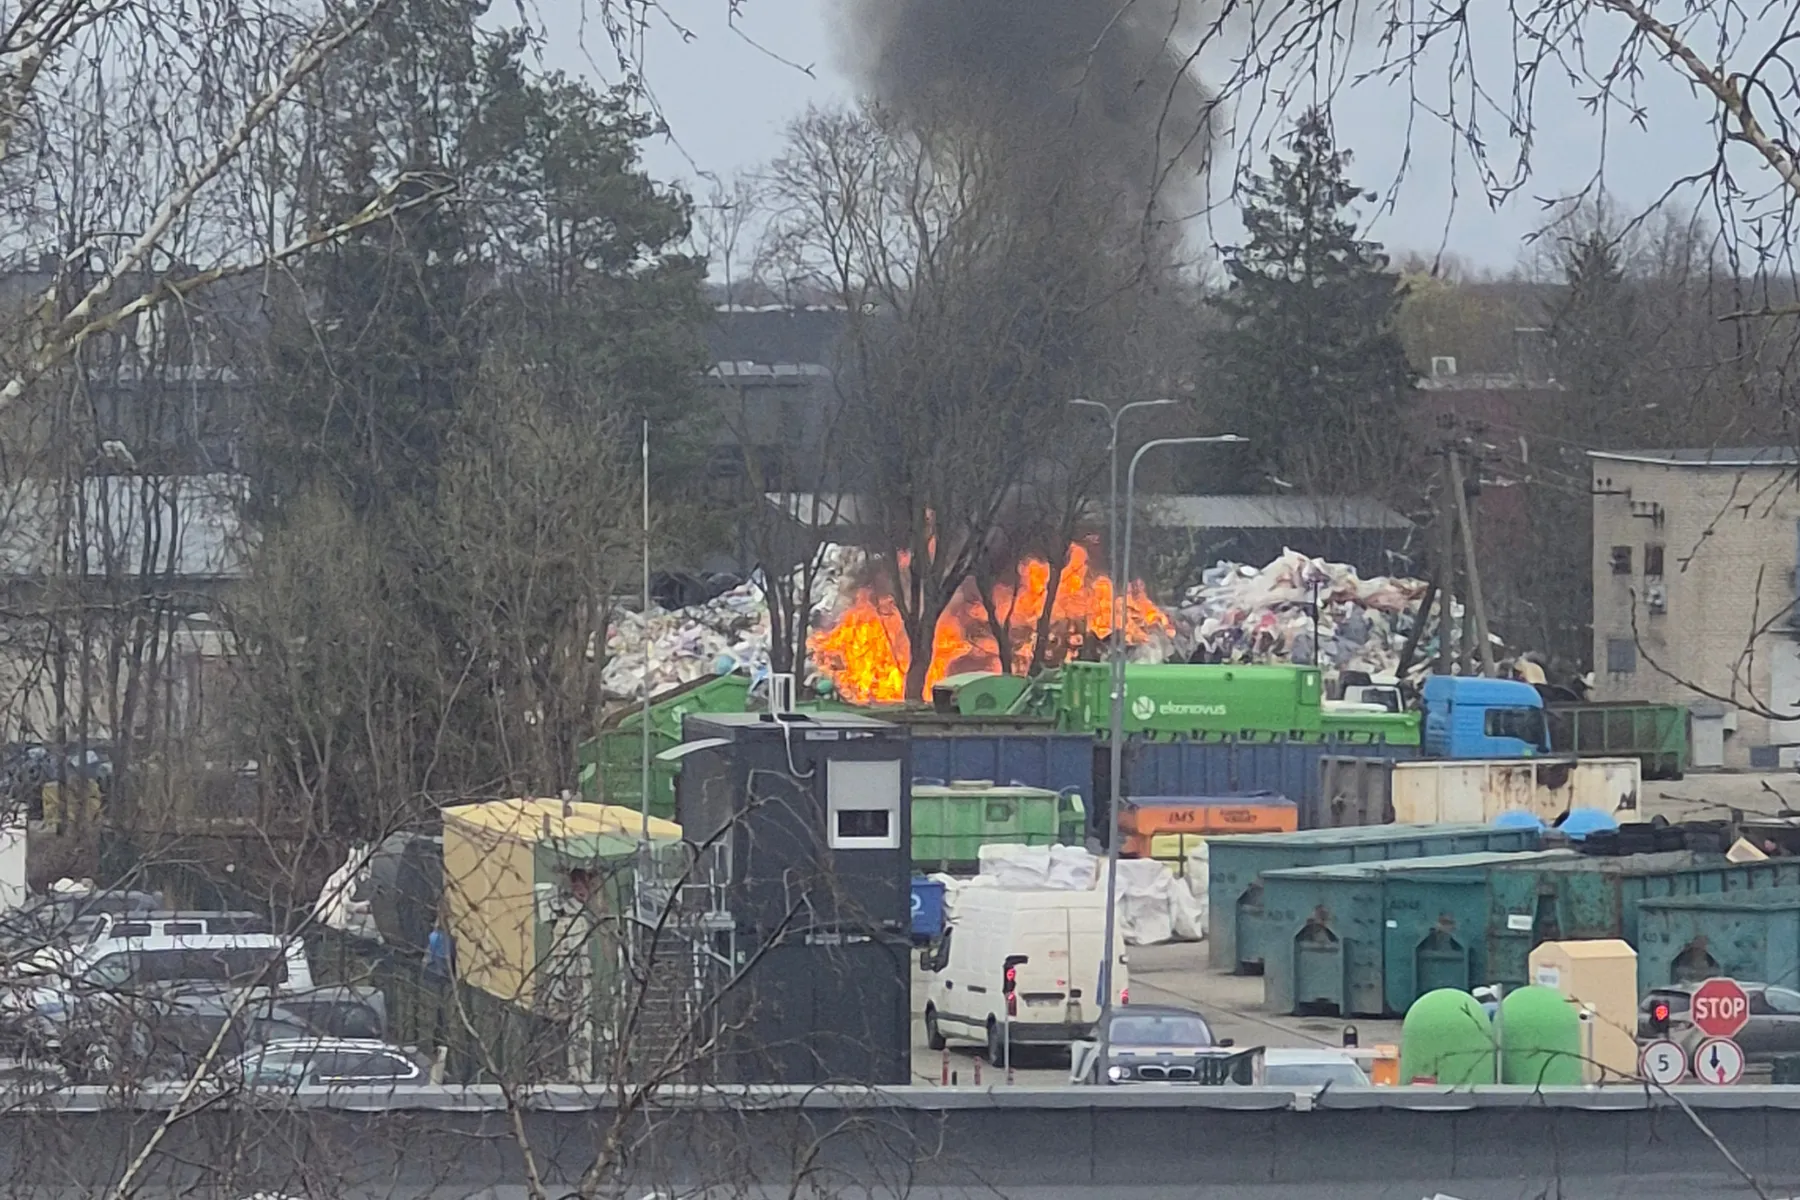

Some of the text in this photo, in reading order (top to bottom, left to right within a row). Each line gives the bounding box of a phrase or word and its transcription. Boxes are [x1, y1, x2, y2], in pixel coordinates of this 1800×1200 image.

[1159, 700, 1227, 715] ekonovus
[1695, 997, 1745, 1019] STOP
[1658, 1054, 1669, 1072] 5
